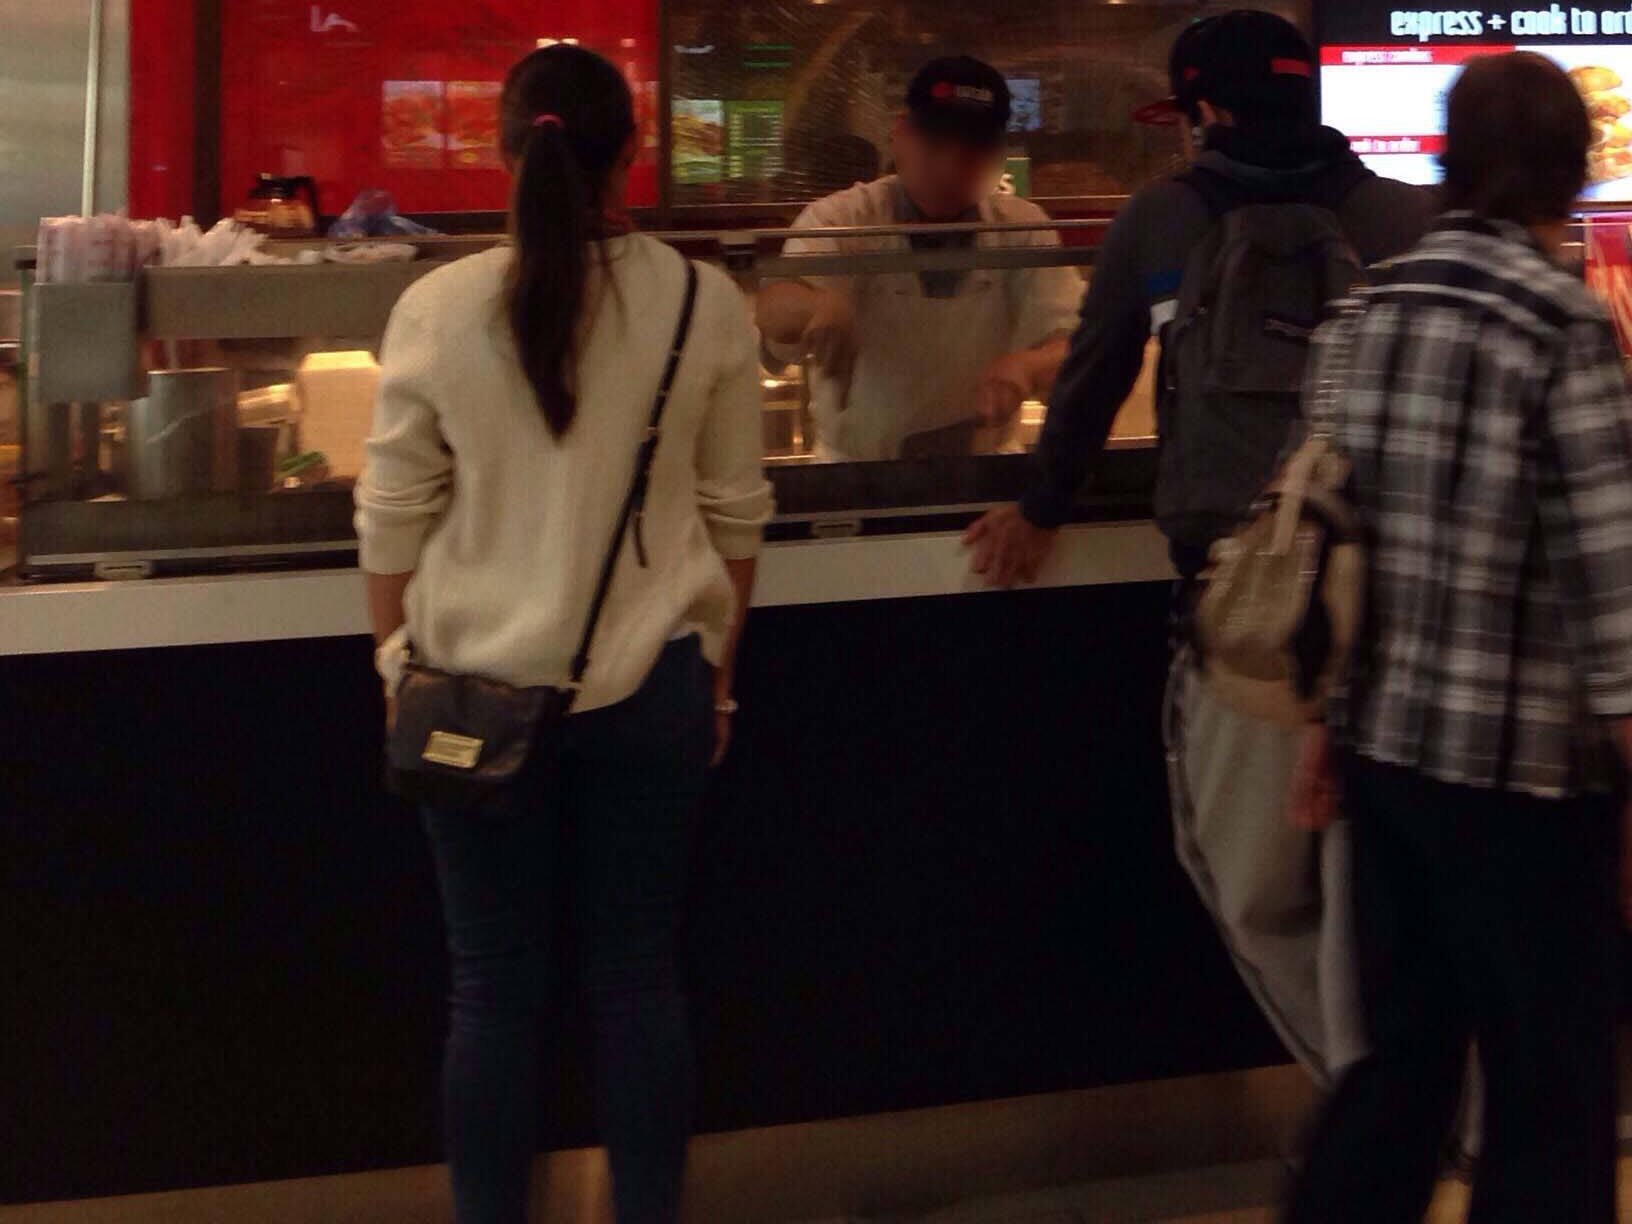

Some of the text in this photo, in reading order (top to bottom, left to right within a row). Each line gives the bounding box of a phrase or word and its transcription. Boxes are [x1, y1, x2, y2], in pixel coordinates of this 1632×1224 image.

[1390, 10, 1483, 42] express
[1511, 4, 1568, 36] cook
[1571, 7, 1597, 35] to
